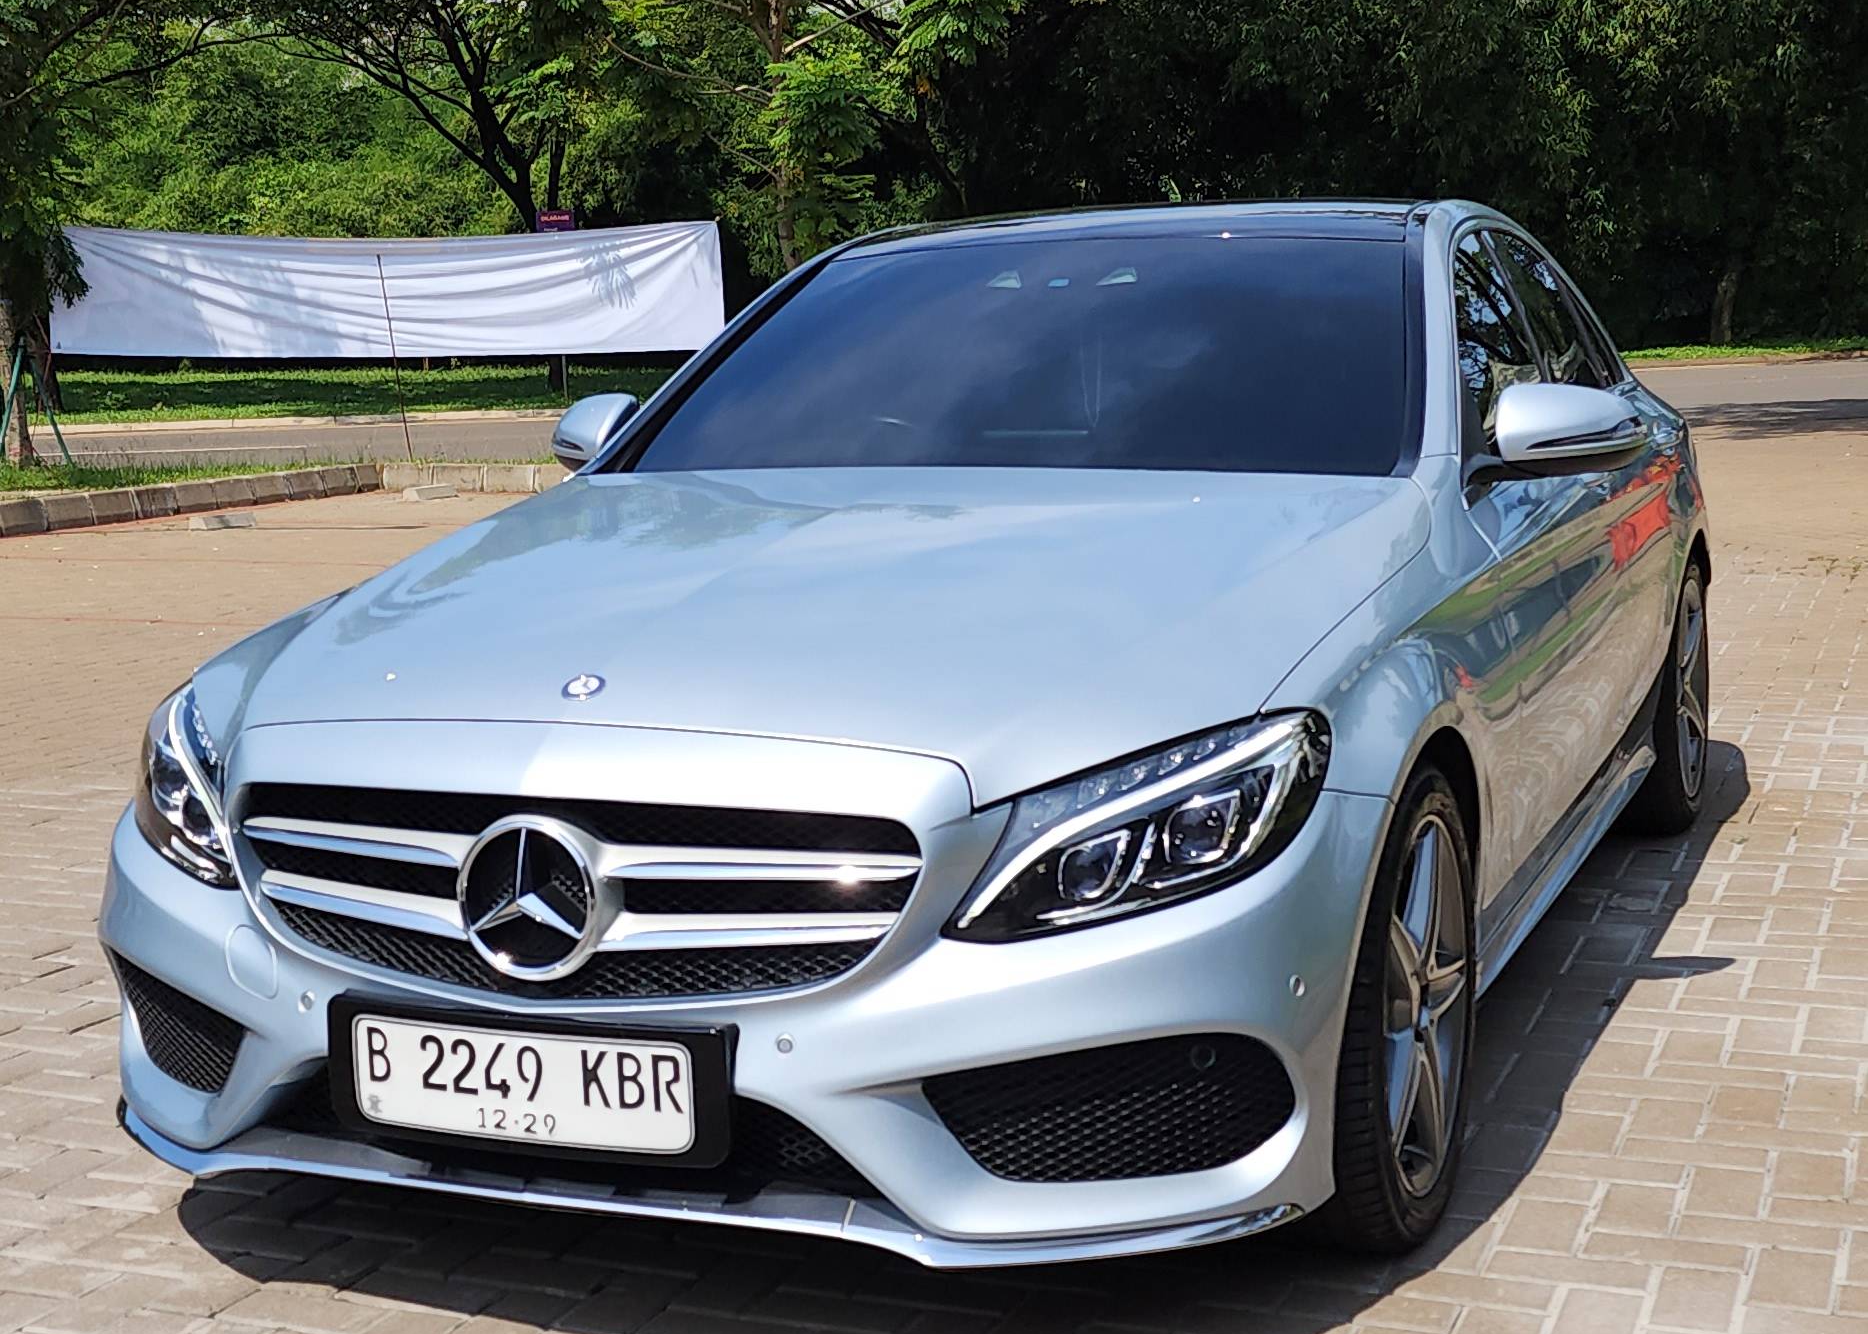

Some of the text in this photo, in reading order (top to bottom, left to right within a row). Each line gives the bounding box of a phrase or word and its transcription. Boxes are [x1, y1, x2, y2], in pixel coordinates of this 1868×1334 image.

[366, 1026, 684, 1114] B 2249 KBR
